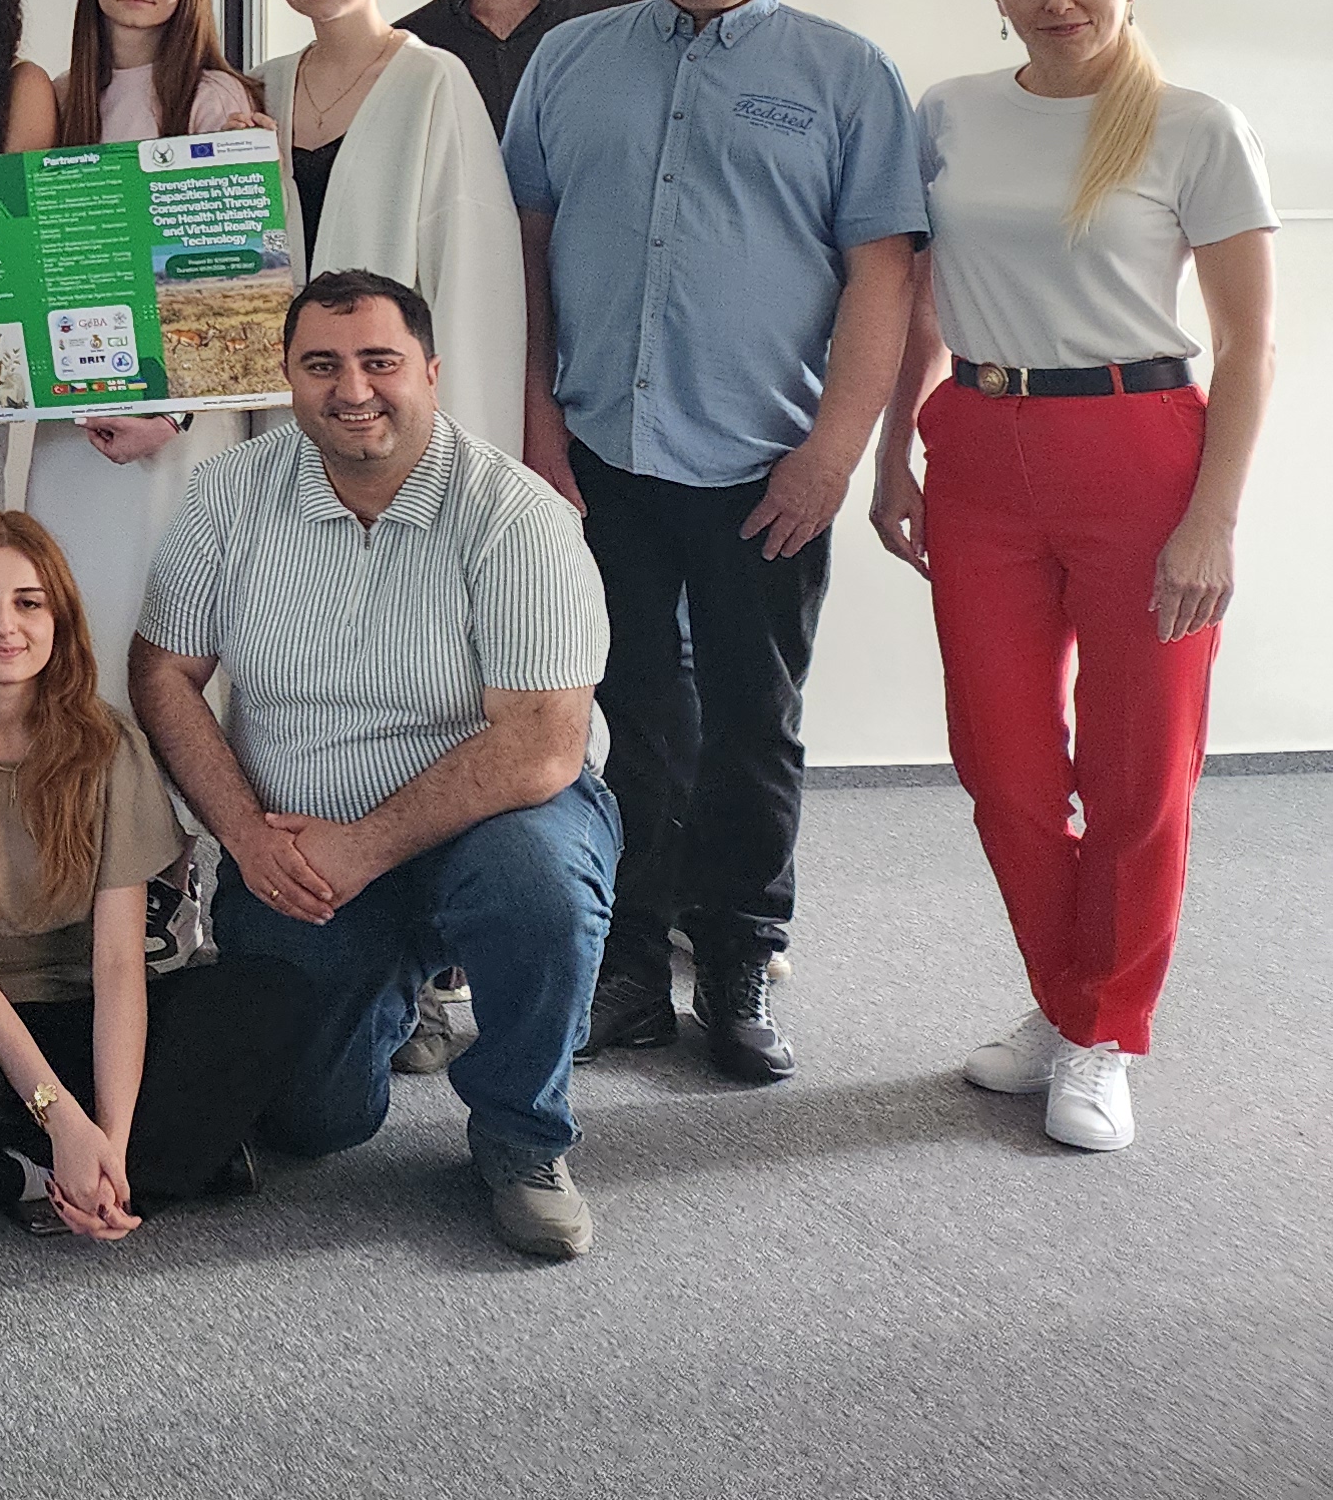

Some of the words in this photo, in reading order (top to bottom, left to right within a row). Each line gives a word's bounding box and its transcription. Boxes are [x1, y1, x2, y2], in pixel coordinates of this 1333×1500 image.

[733, 100, 814, 130] Redcrest
[42, 152, 101, 167] Partnership
[149, 176, 229, 192] Strengthening
[229, 173, 265, 185] Youth
[151, 189, 210, 204] Capacities
[211, 188, 222, 198] in
[222, 184, 266, 197] Wildlife
[149, 200, 223, 215] Conservation
[223, 196, 271, 208] Through
[153, 216, 177, 226] One
[178, 211, 215, 225] Health
[216, 209, 270, 221] Initiatives
[162, 226, 184, 237] and
[185, 222, 223, 235] Virtual
[223, 220, 263, 232] Reality
[181, 233, 247, 247] Technology
[79, 355, 106, 365] BRIT
